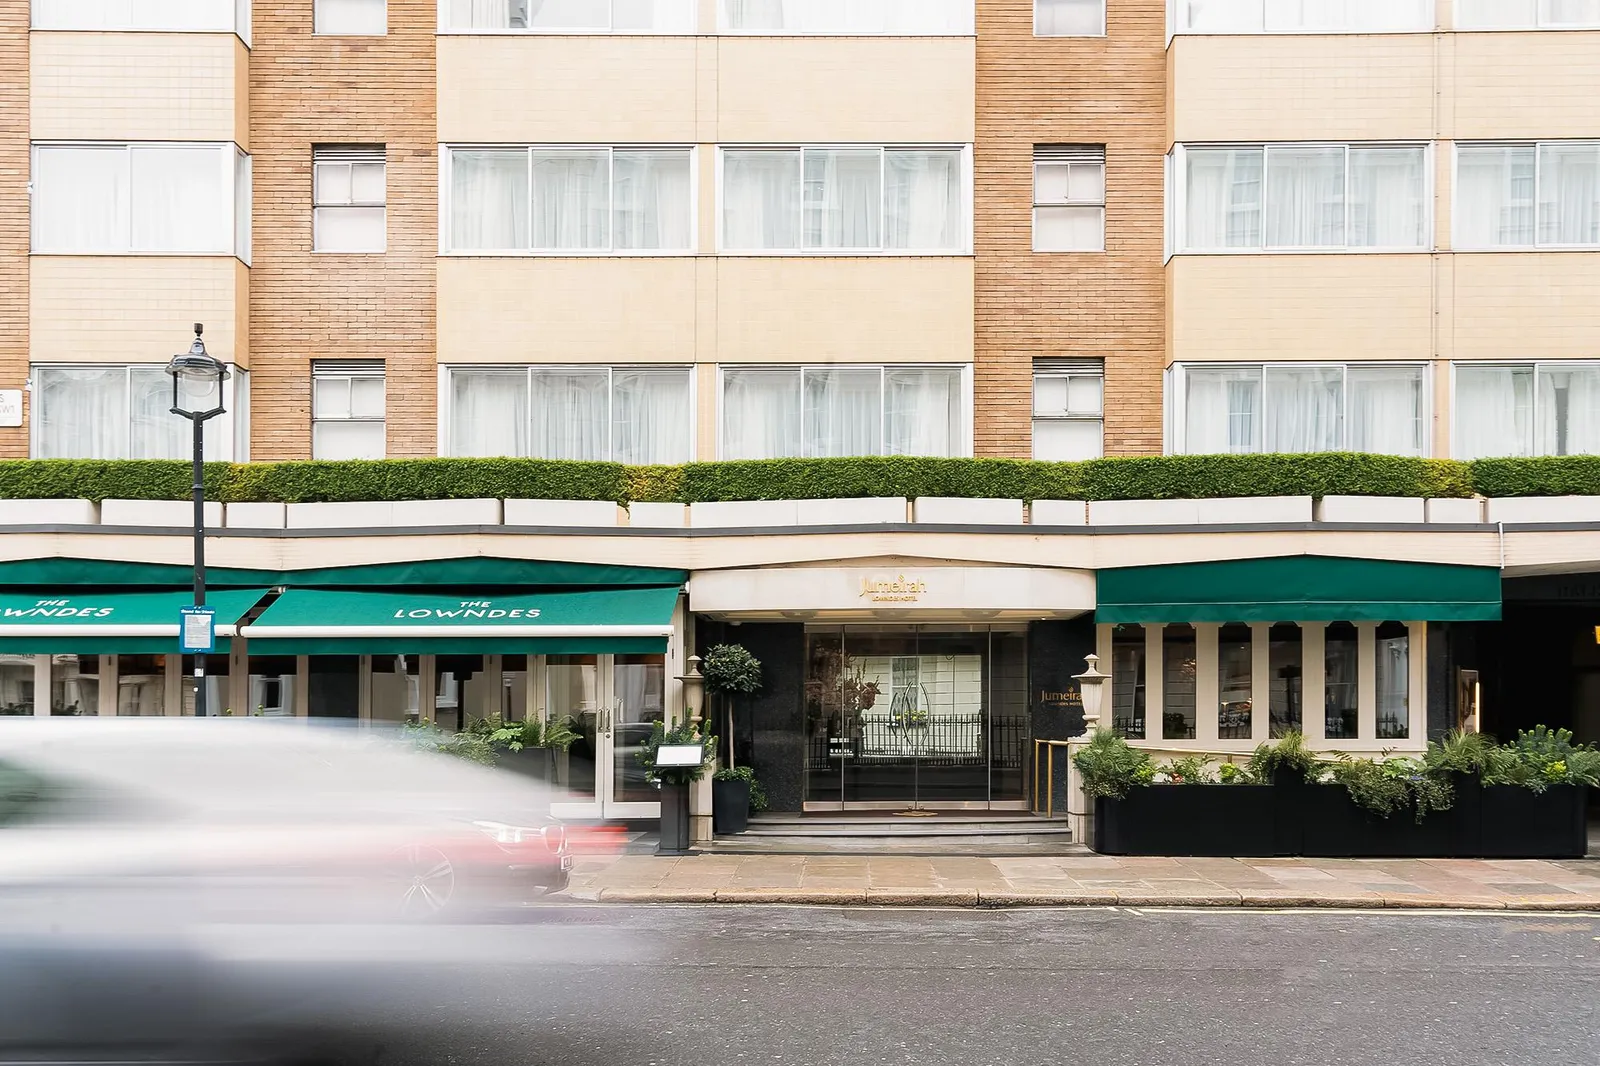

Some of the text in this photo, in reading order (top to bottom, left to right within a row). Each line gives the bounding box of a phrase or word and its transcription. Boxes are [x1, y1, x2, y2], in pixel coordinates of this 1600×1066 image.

[859, 574, 928, 597] Jumeirah
[35, 599, 71, 607] THE
[0, 607, 115, 617] WNDES
[393, 609, 542, 618] LOWNDES
[1040, 686, 1082, 703] Jumeira
